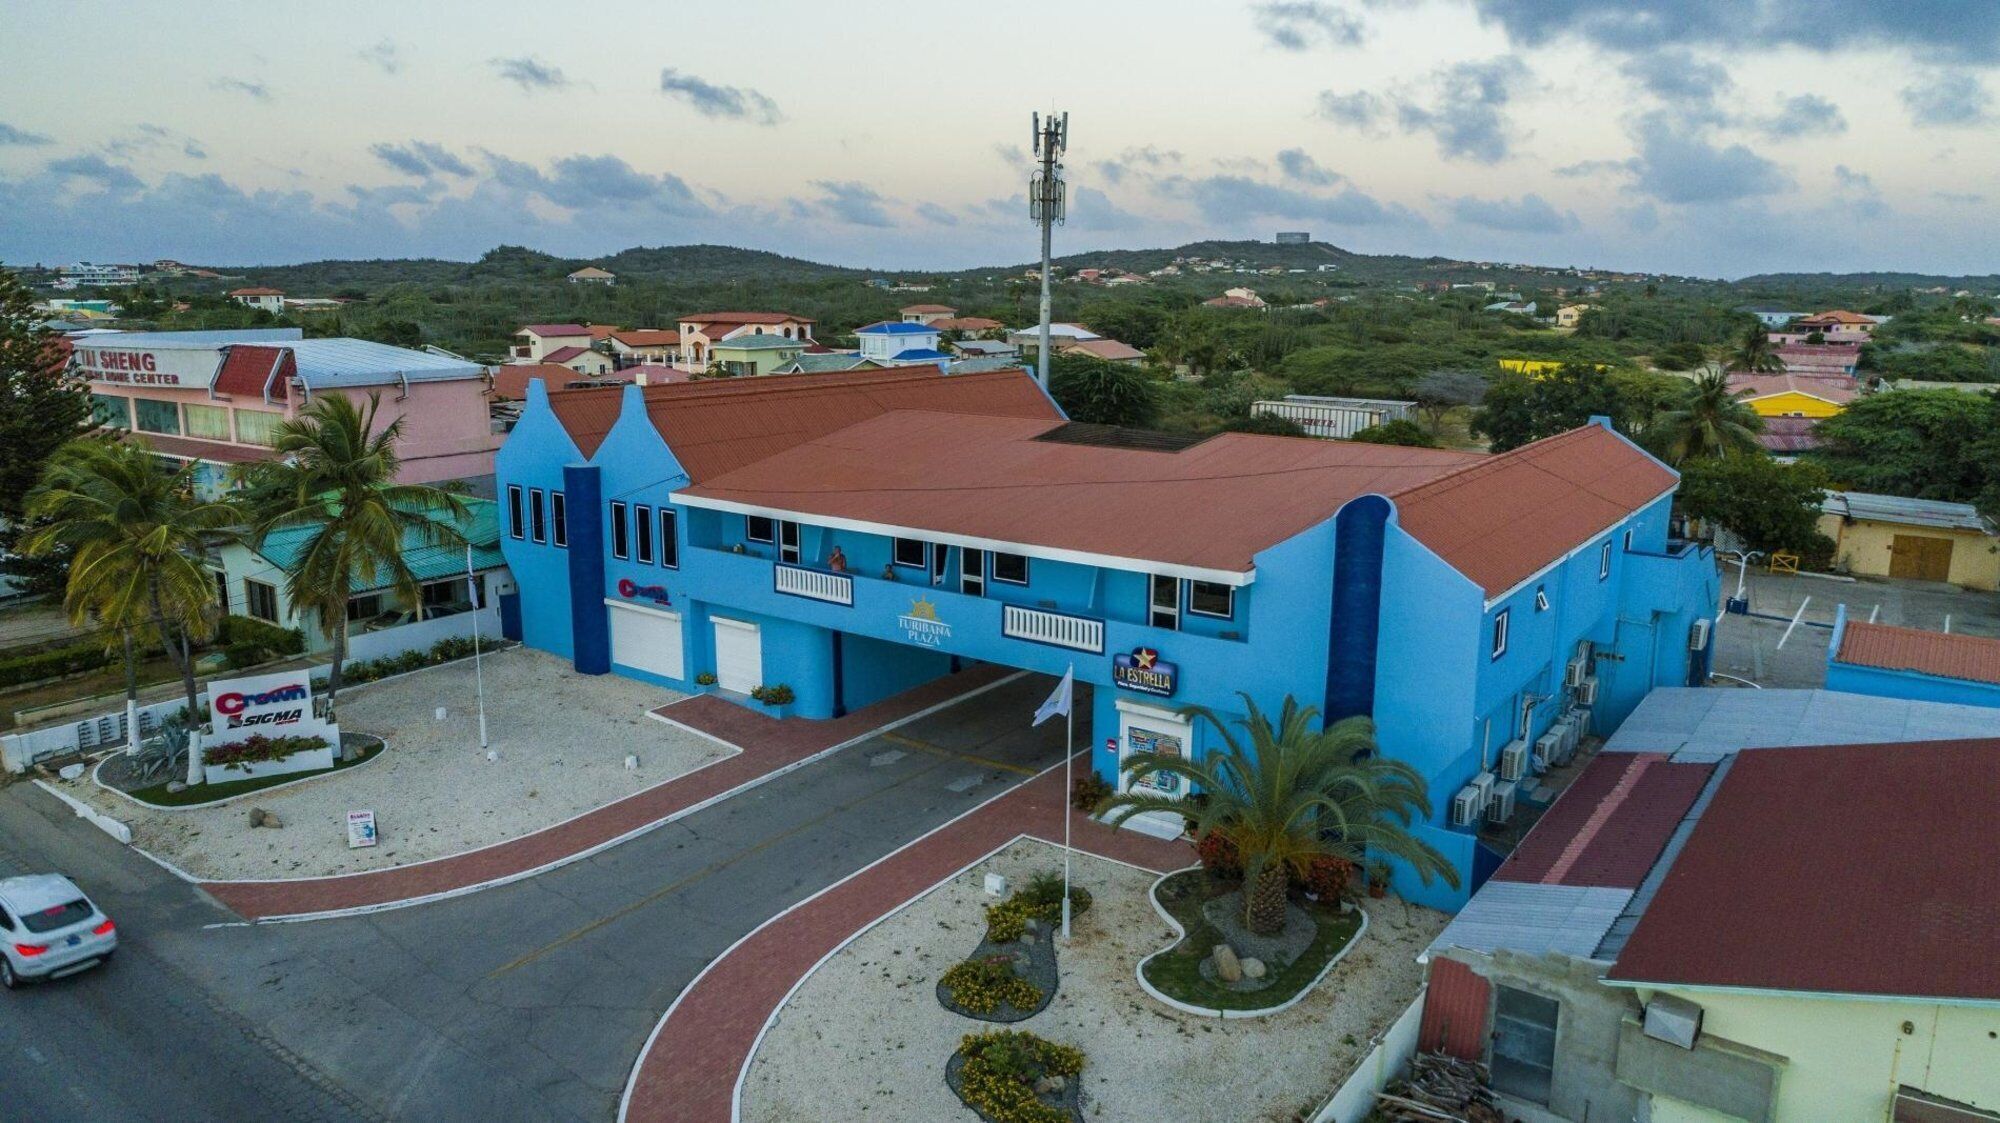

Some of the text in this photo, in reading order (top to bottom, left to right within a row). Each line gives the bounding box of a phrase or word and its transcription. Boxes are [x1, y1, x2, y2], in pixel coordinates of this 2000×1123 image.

[100, 350, 157, 372] SHENG
[132, 373, 180, 385] CENTER
[899, 618, 952, 638] TURIBANA
[908, 630, 940, 646] PLAZA
[1114, 665, 1171, 690] LA ESTRELLA
[242, 709, 302, 727] SIGMA
